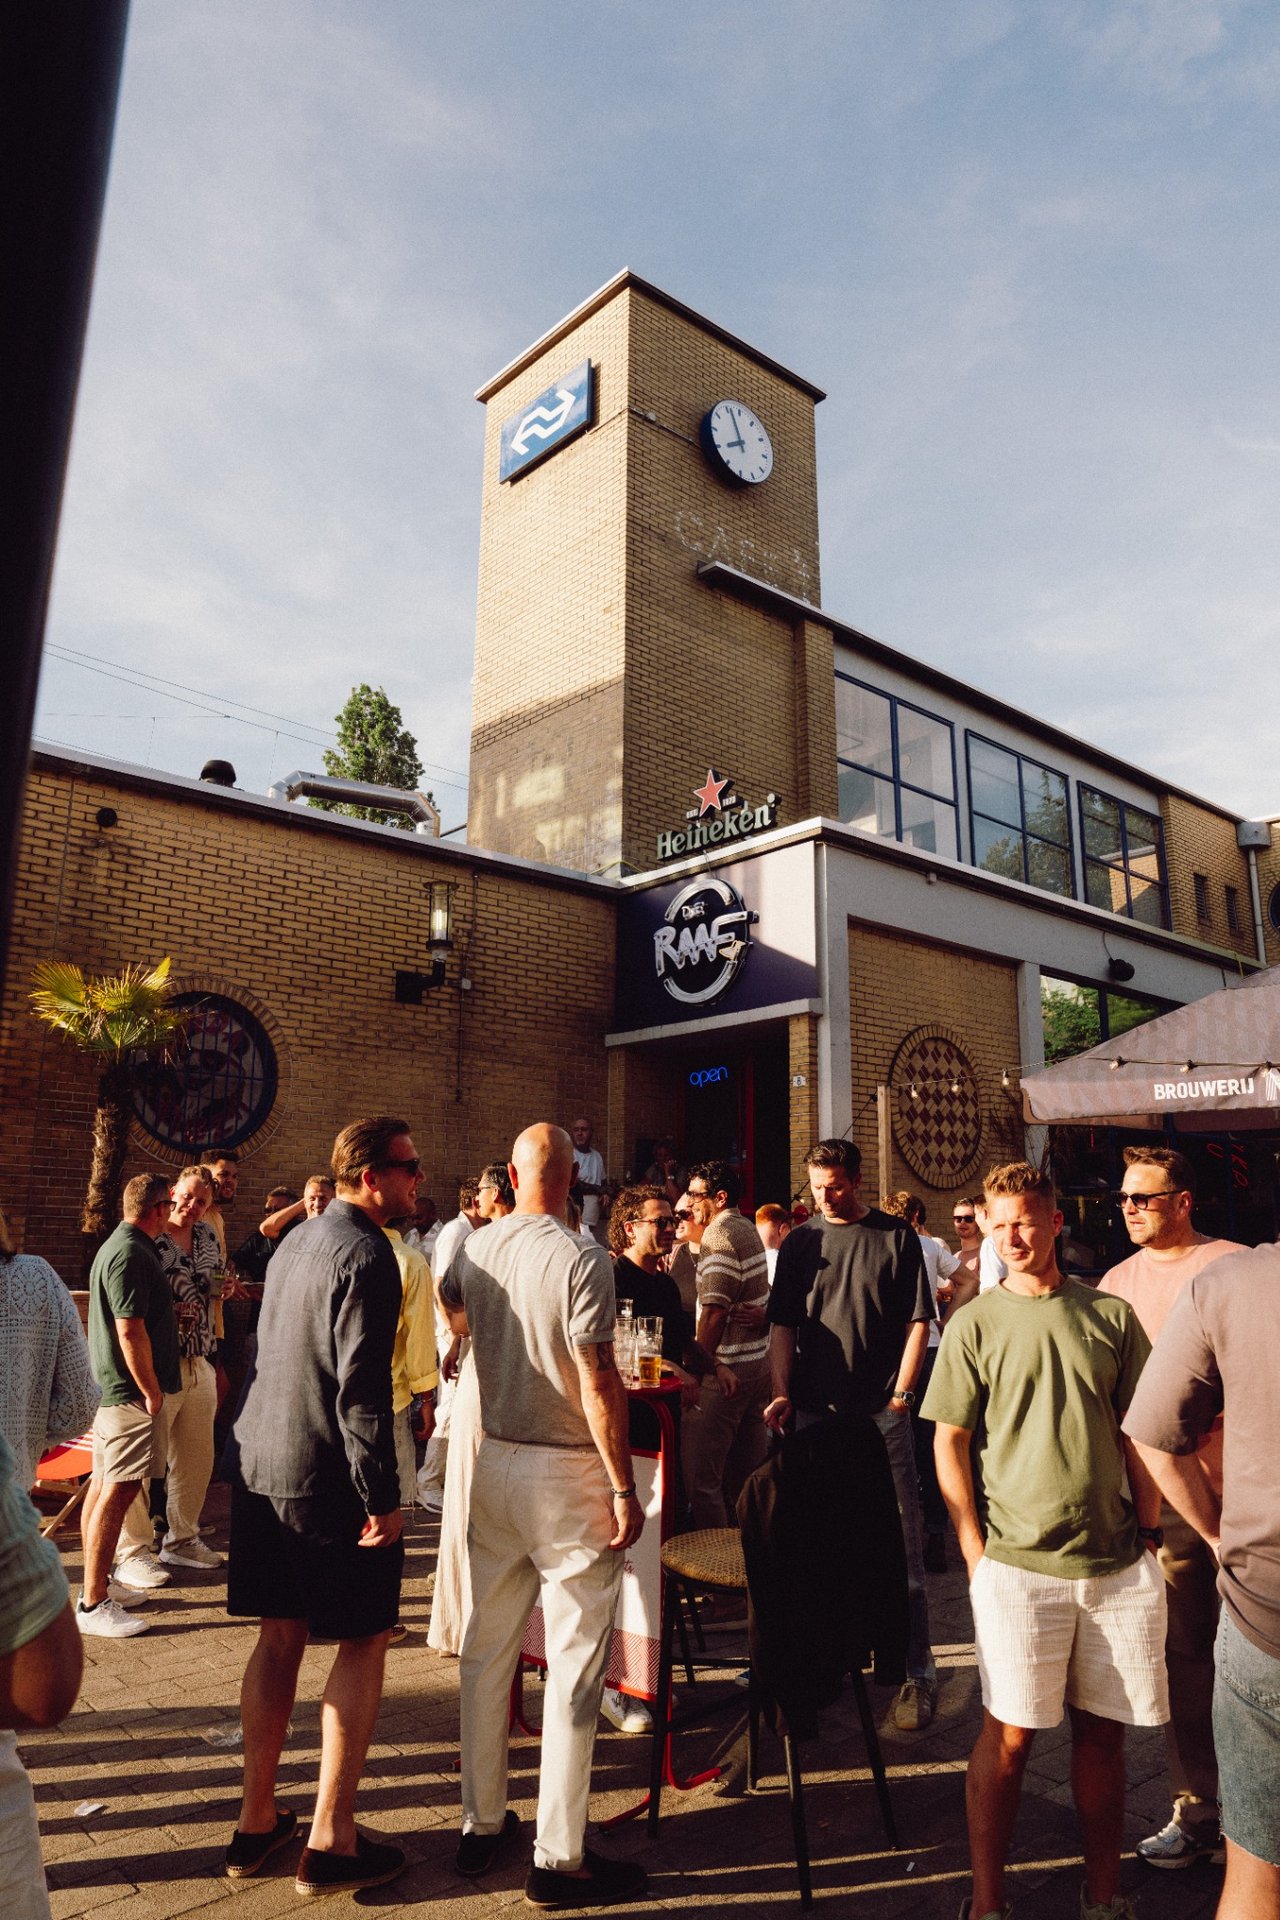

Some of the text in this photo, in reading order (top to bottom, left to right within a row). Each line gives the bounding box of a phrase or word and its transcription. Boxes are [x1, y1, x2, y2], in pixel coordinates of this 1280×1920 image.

[656, 804, 772, 860] Heineken
[681, 901, 706, 920] DE
[653, 911, 748, 978] RAAF
[690, 1066, 729, 1087] open
[1153, 1077, 1255, 1100] BROUWERIJ
